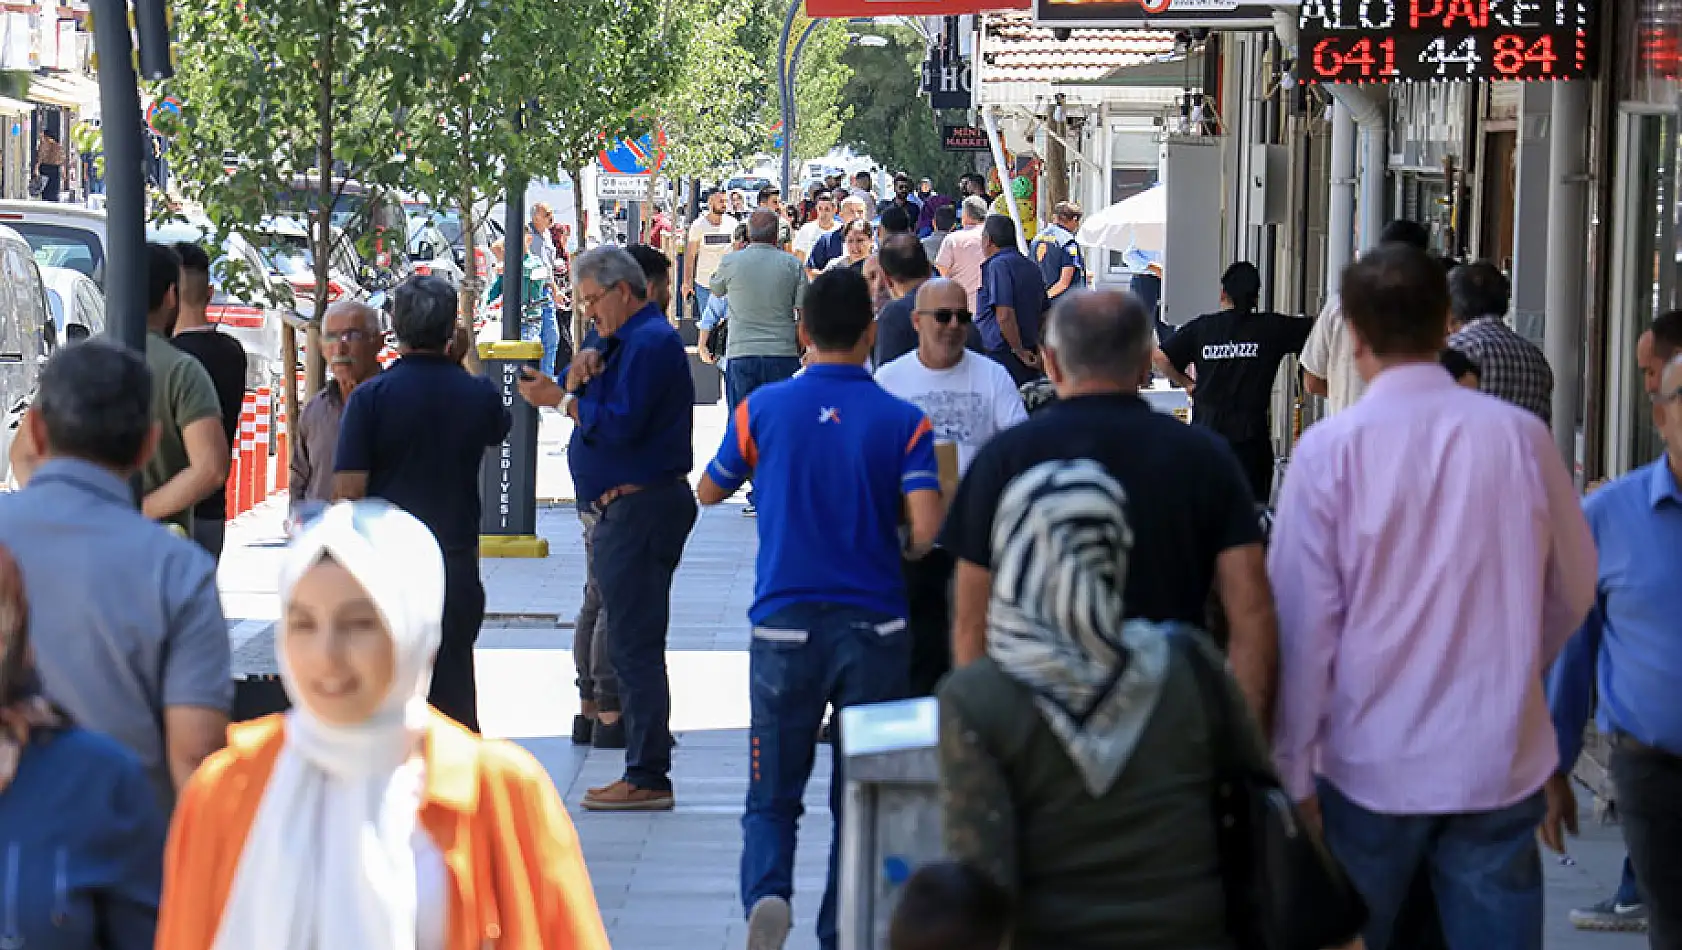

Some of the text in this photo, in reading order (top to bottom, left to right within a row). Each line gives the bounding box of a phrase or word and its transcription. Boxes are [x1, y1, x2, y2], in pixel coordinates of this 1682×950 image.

[1300, 0, 1395, 28] ALO
[1312, 34, 1557, 75] 641 44 84
[500, 363, 514, 528] KULU LEDİYESİ
